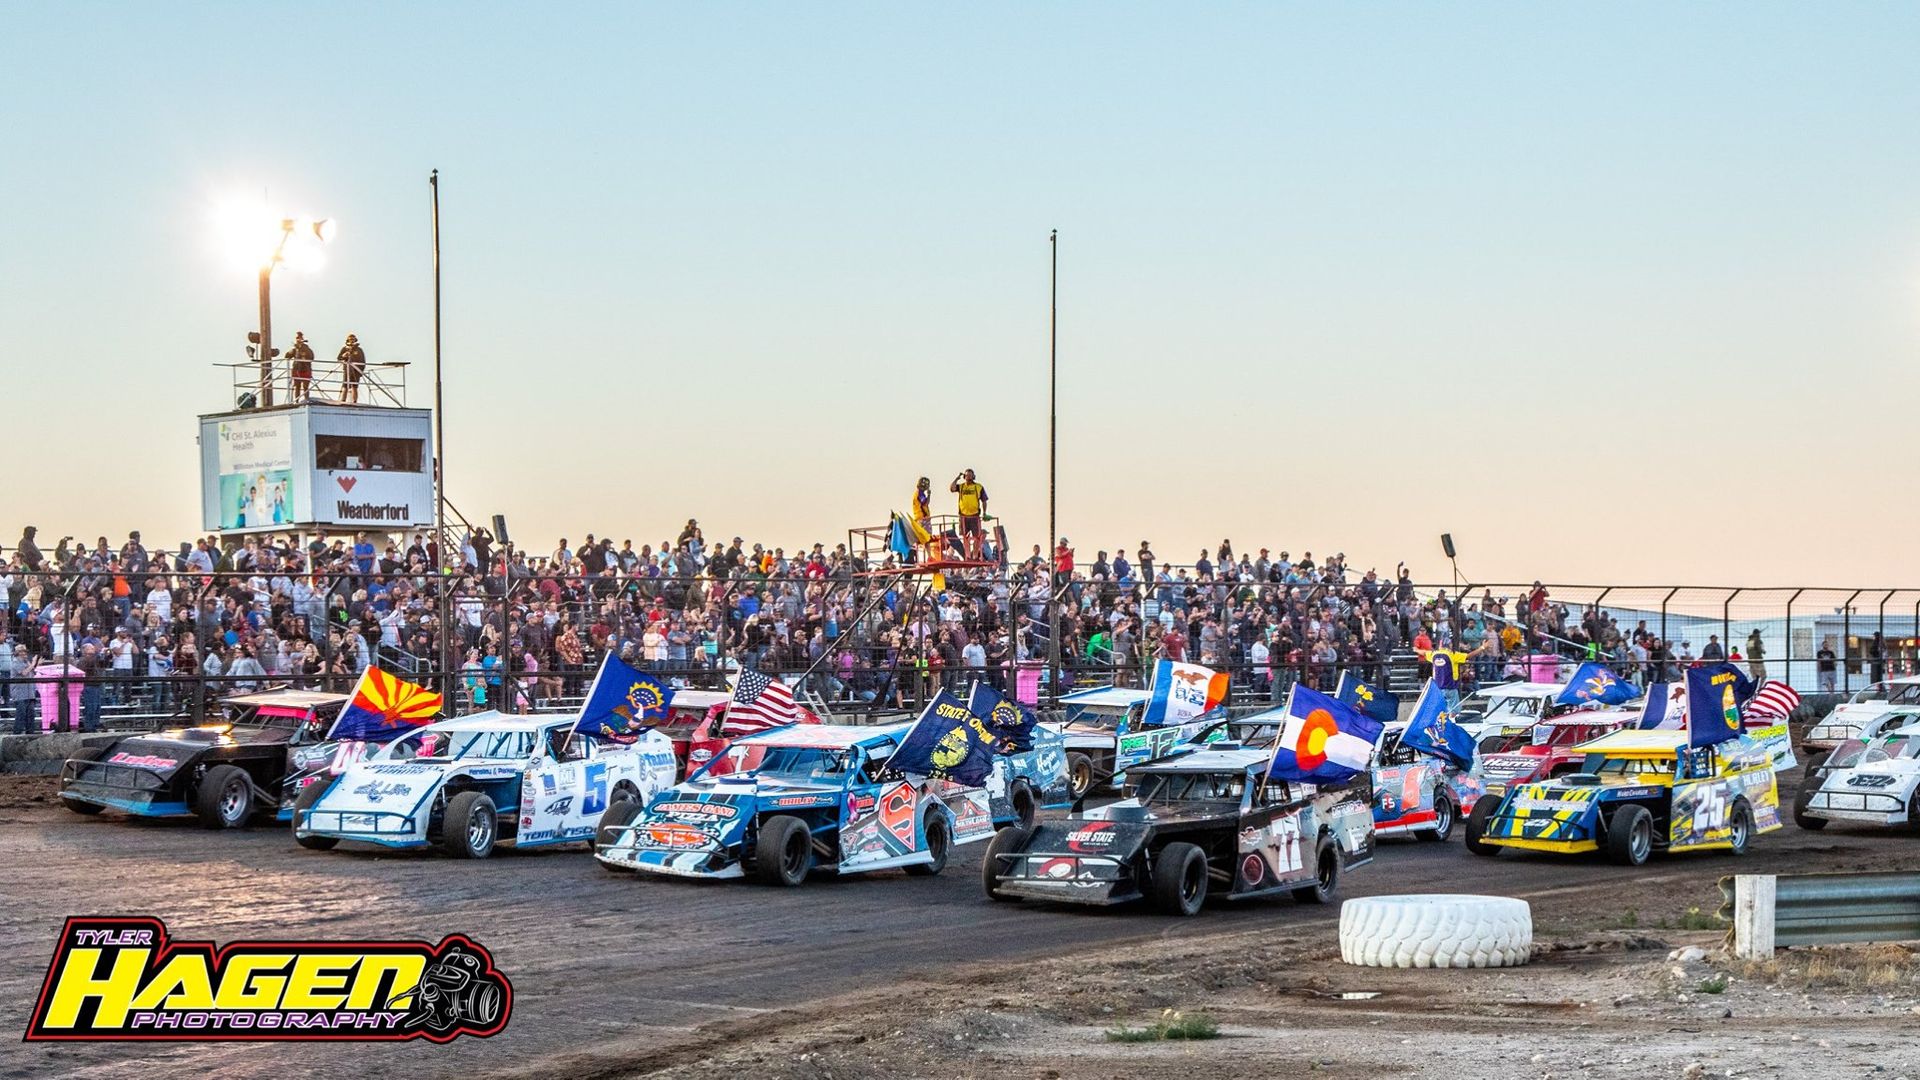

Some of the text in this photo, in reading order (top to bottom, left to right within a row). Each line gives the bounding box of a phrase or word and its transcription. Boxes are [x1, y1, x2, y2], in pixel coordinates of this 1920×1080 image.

[337, 500, 409, 520] Weatherford
[936, 703, 966, 720] STATE
[1482, 757, 1541, 768] Harris
[581, 762, 608, 816] 5
[654, 803, 737, 817] JAMES GANG
[1693, 782, 1727, 831] 25
[665, 811, 719, 822] PIZZA
[1066, 832, 1116, 842] SILVER STATE
